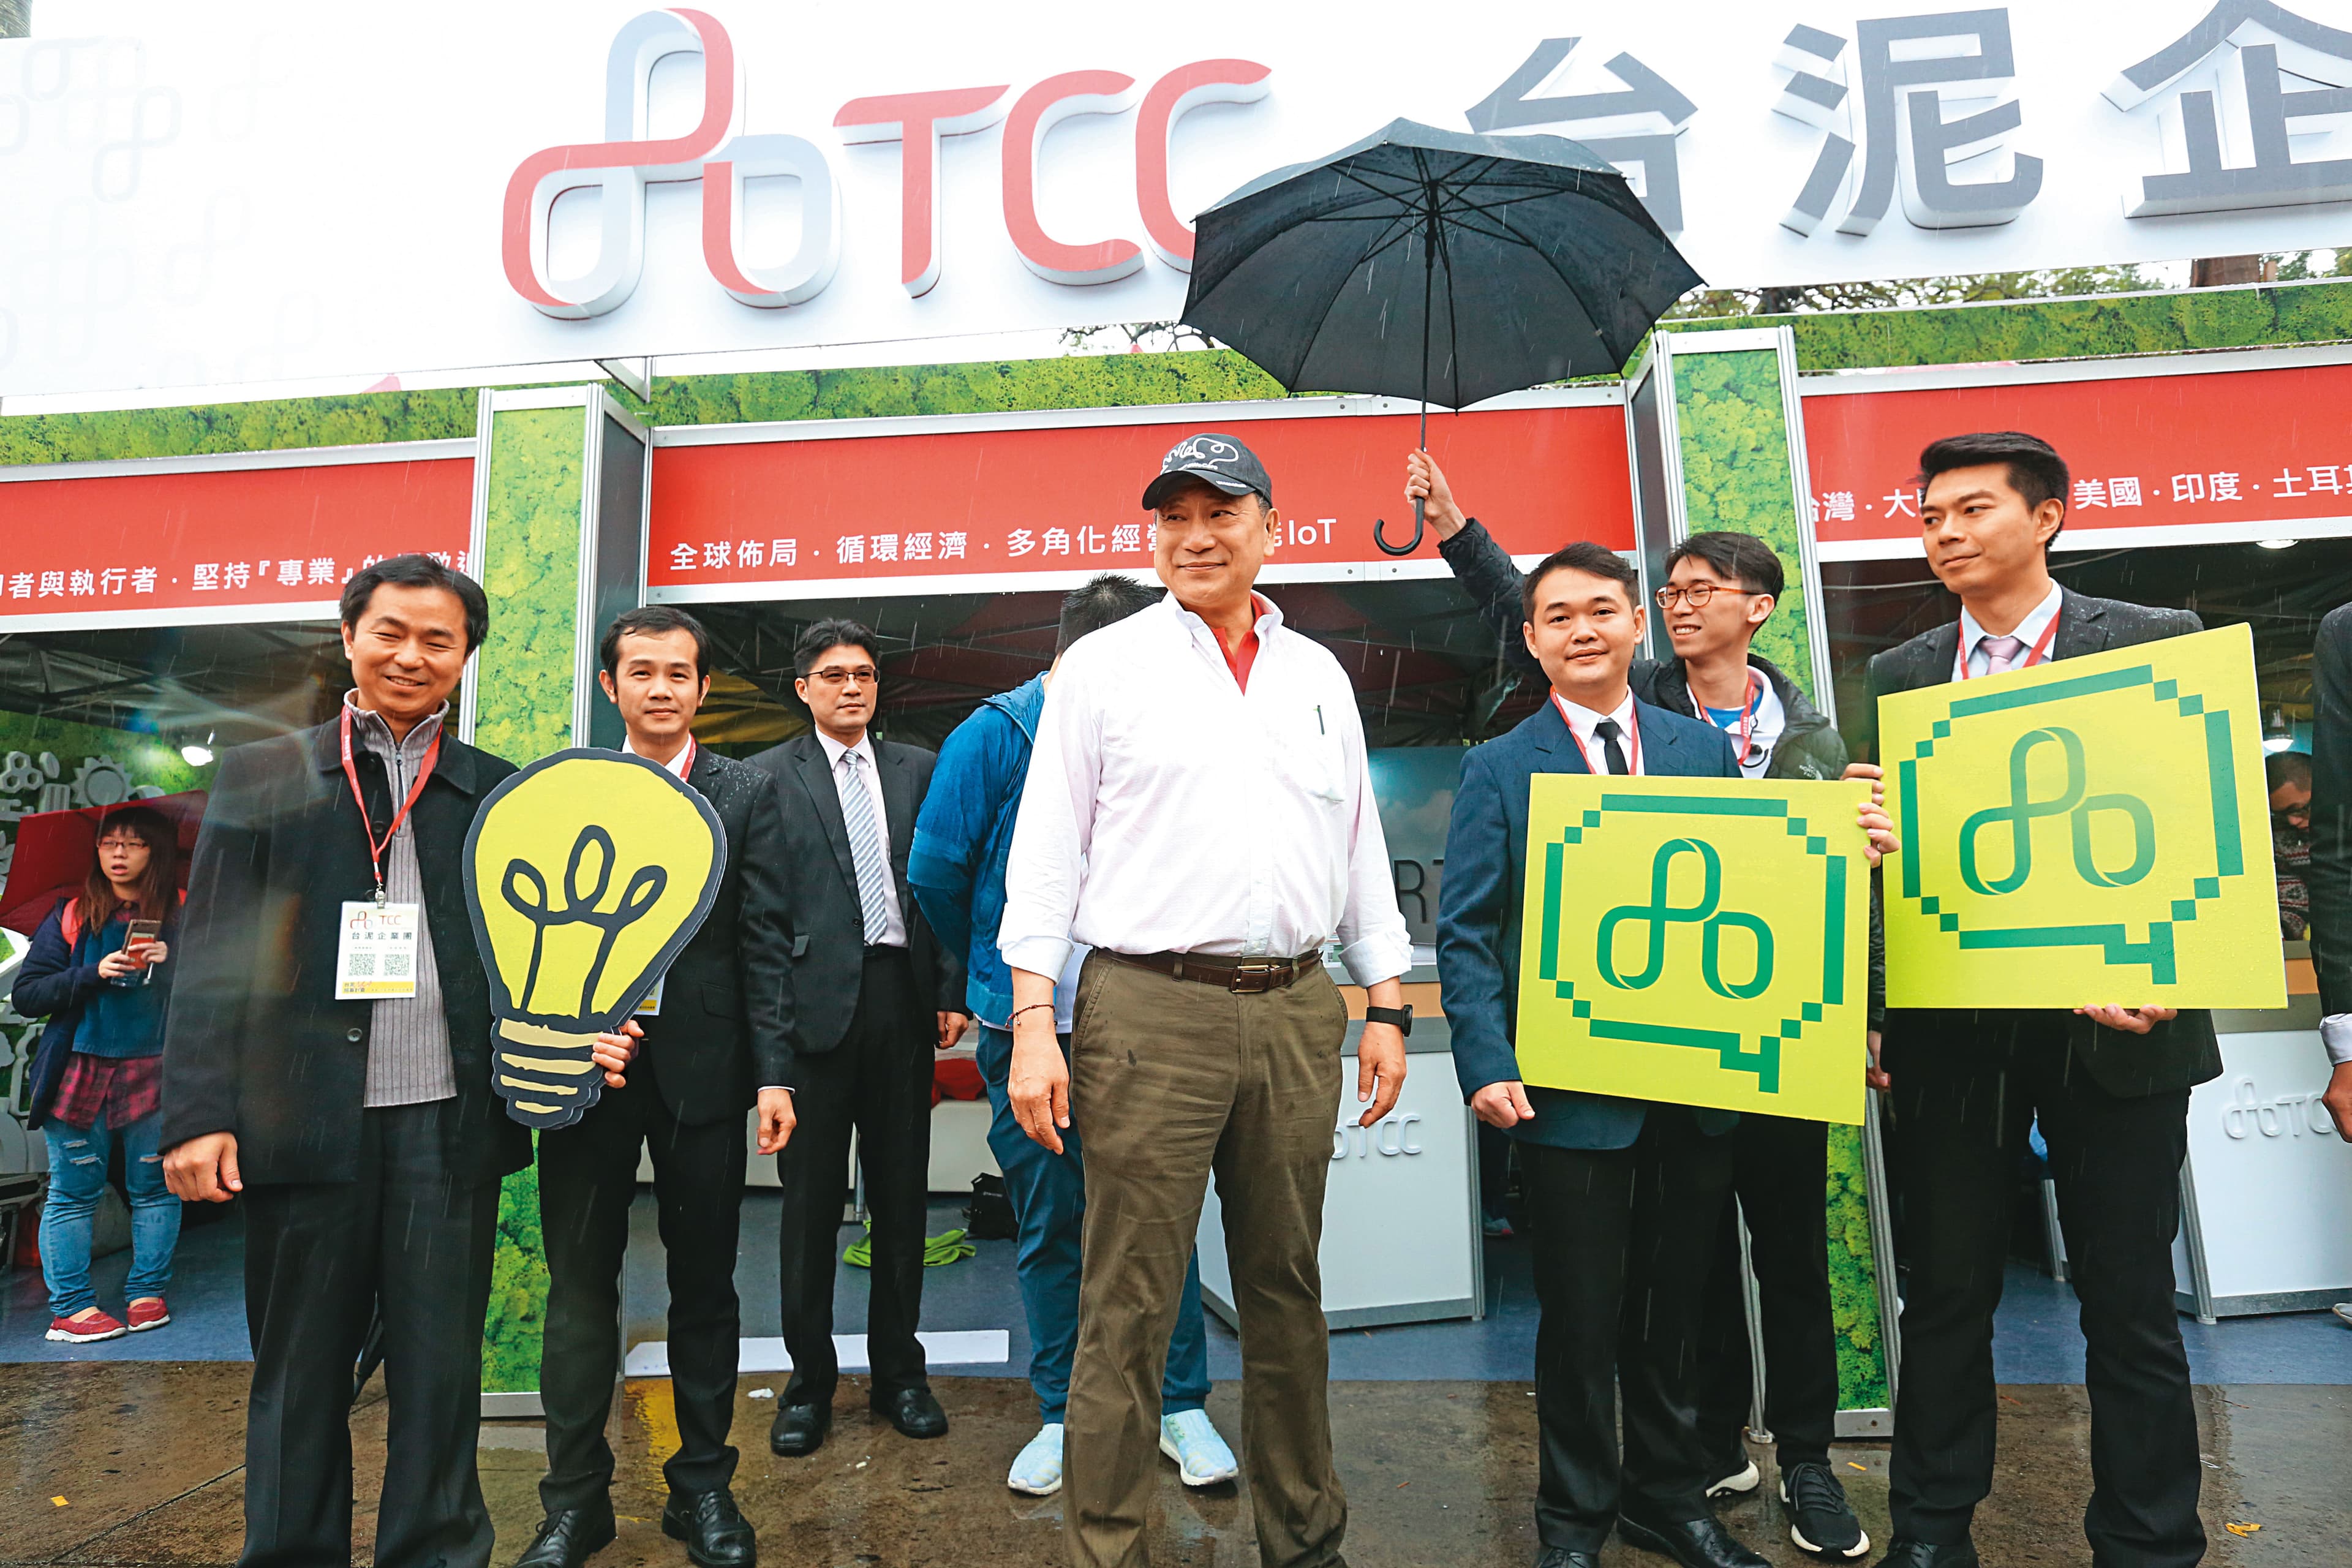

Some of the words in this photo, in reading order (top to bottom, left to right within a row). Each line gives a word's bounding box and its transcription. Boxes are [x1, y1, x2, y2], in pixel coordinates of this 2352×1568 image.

[1464, 0, 2352, 238] 台泥企
[833, 58, 1273, 298] TCC
[1882, 489, 1923, 518] 大
[2073, 477, 2143, 510] 美國
[2171, 472, 2243, 503] 印度
[670, 539, 797, 570] 全球佈局
[836, 531, 967, 564] 循環經濟
[1273, 519, 1337, 547] IoT
[379, 914, 402, 925] TCC
[1346, 1114, 1422, 1158] TCC
[2274, 1091, 2339, 1137] TC
